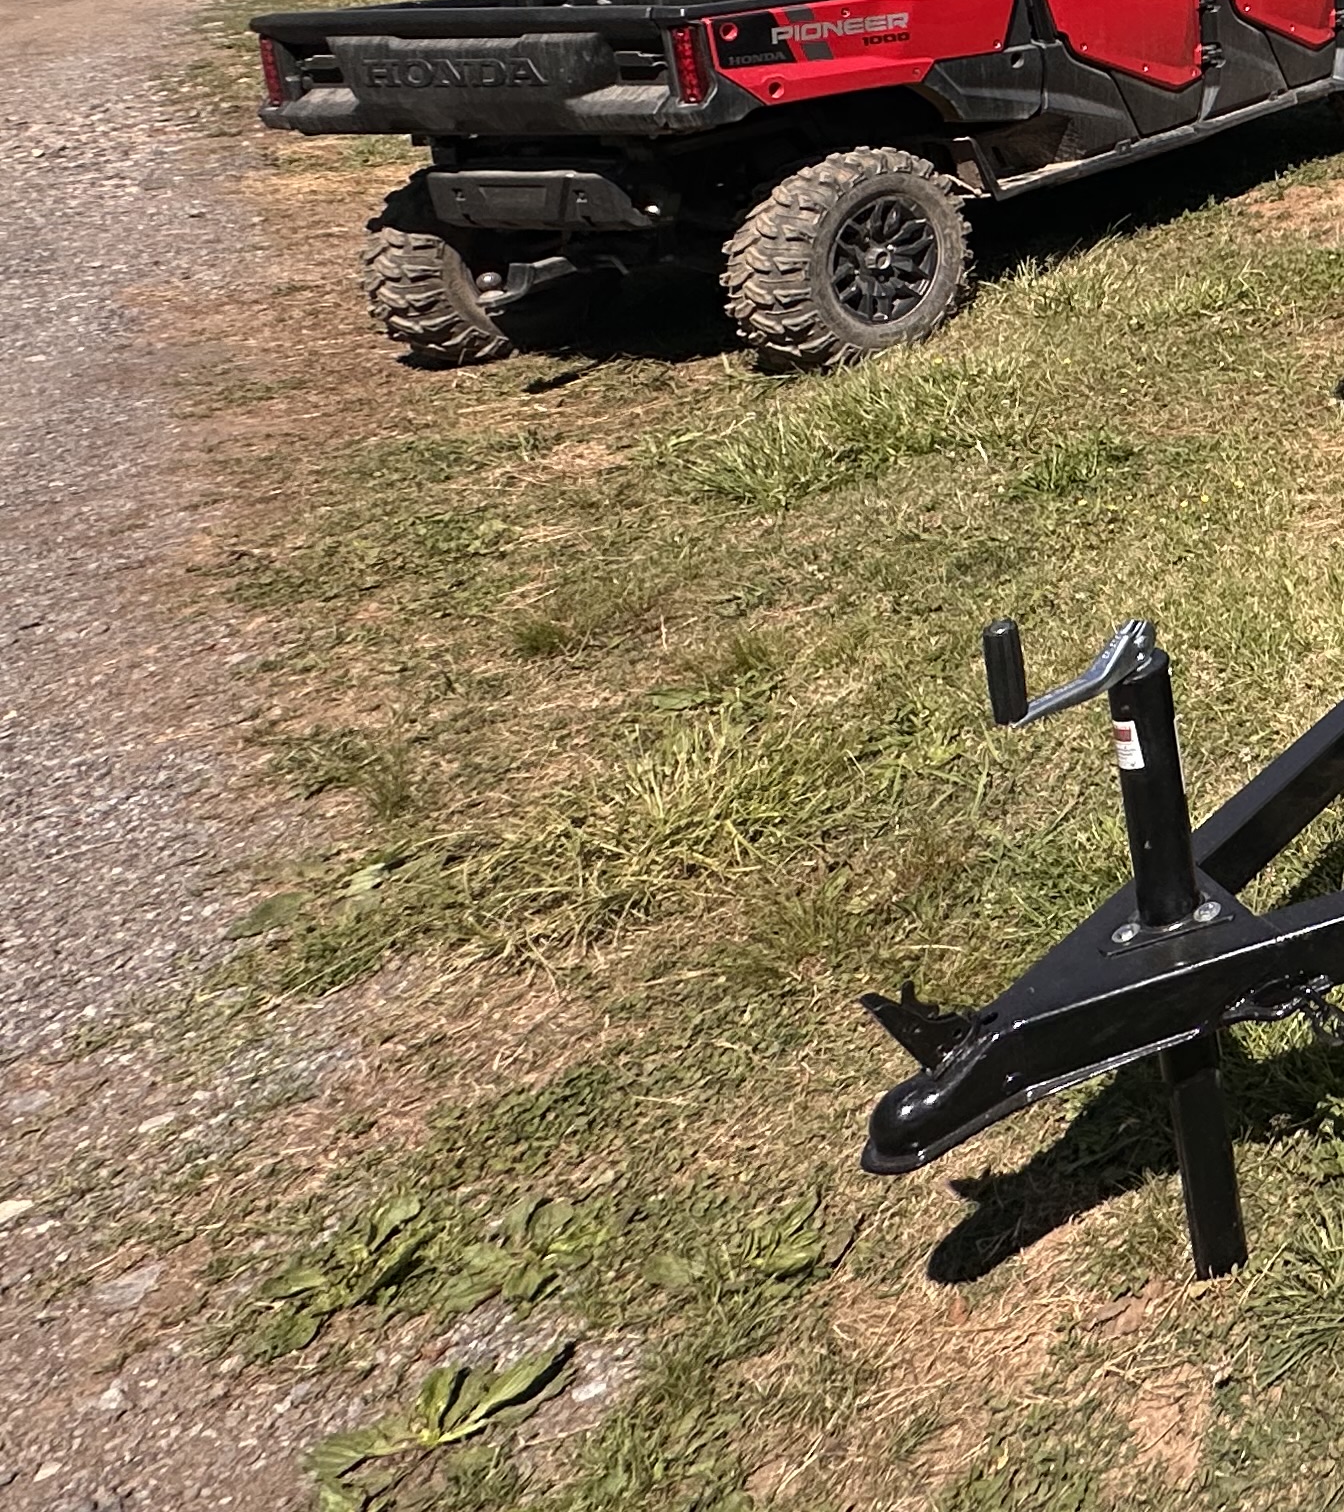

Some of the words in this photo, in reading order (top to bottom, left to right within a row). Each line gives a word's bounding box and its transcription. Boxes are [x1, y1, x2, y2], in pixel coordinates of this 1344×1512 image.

[770, 11, 910, 45] PIONEER
[861, 31, 911, 47] 1000
[728, 50, 787, 67] HONDA
[362, 57, 550, 88] HONDA
